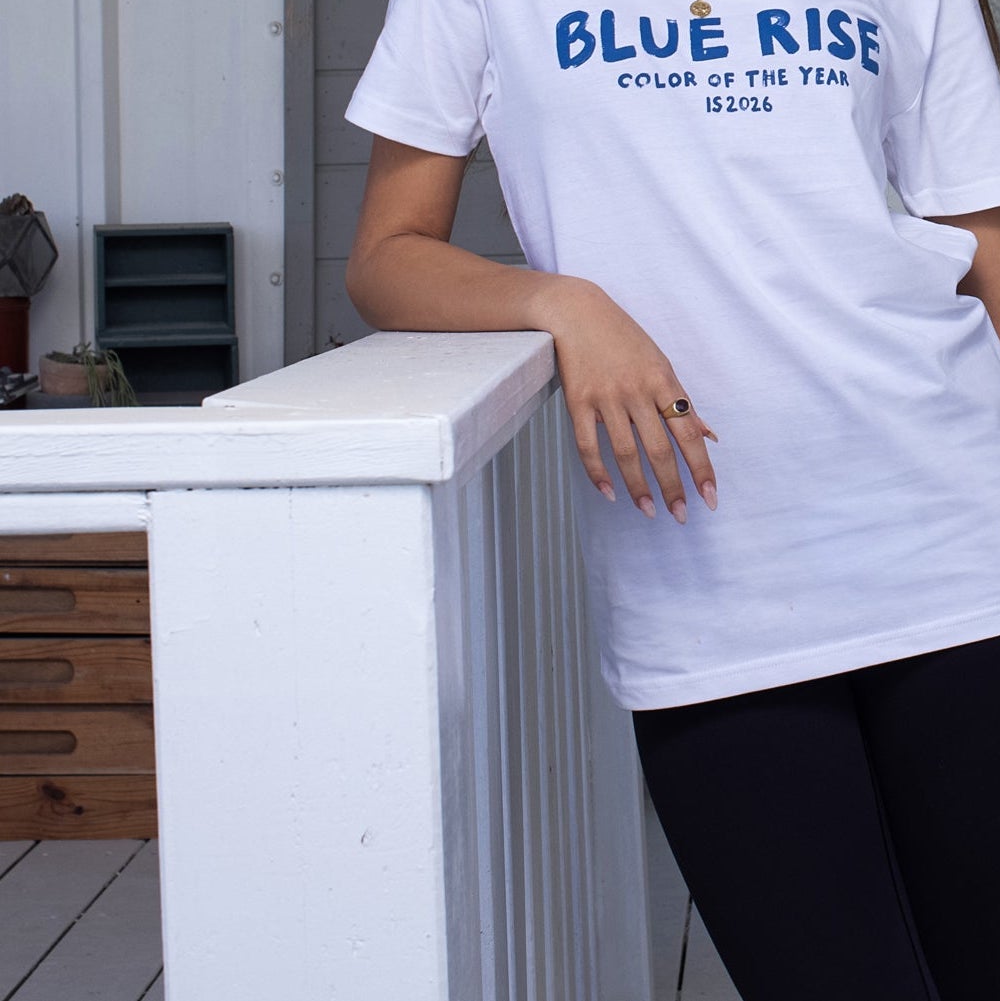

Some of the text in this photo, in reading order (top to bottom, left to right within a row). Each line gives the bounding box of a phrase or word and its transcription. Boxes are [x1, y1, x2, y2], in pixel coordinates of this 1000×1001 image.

[555, 7, 881, 77] BLUE RISE
[617, 65, 850, 89] COLOR OF THE YEAR
